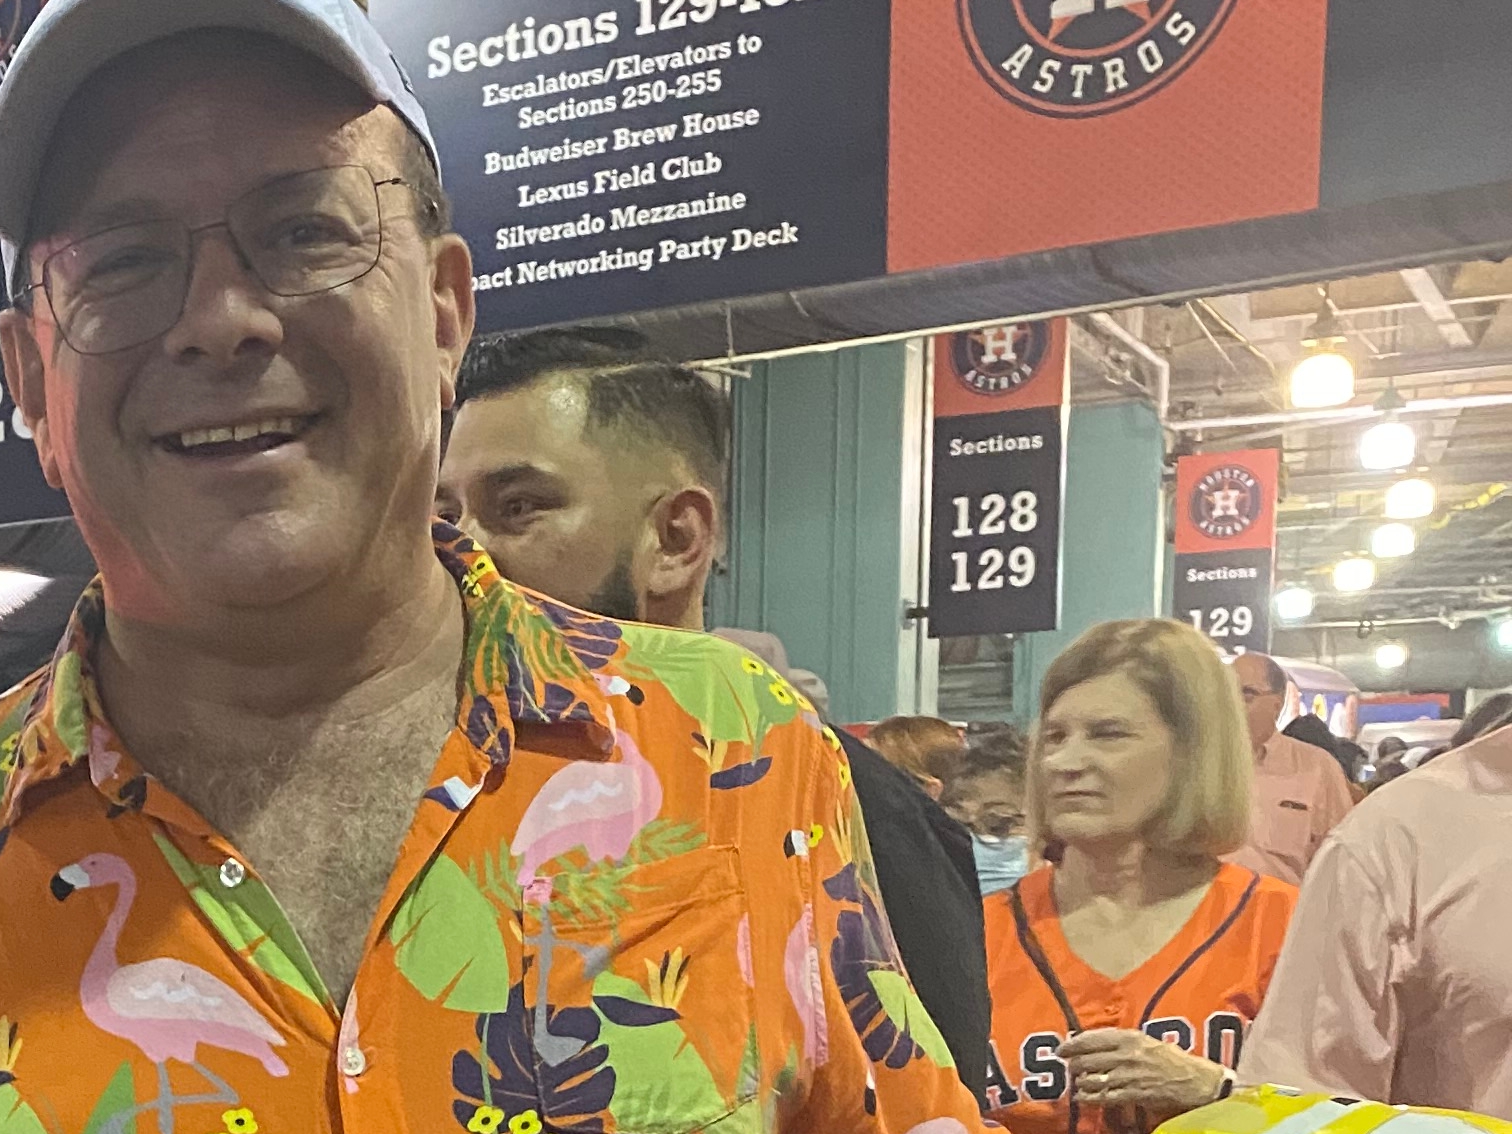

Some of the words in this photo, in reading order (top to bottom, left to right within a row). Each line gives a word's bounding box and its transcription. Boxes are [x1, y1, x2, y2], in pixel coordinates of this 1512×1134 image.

[427, 11, 618, 79] Sections
[482, 41, 732, 107] Escalators/Elevators
[737, 33, 763, 55] to
[1001, 11, 1196, 98] ASTROS
[518, 94, 617, 129] Sections
[622, 69, 722, 110] 250-255
[483, 136, 608, 175] Budweiser
[612, 123, 678, 151] Brew
[683, 107, 760, 138] House
[517, 178, 589, 208] Lexus
[594, 165, 656, 195] Field
[661, 152, 723, 182] Club
[495, 213, 605, 251] Silverado
[609, 192, 747, 231] Mezzanine
[517, 248, 654, 285] Networking
[659, 236, 727, 263] Party
[731, 222, 799, 252] Deck
[949, 434, 1043, 456] Sections
[952, 490, 1038, 537] 128
[951, 545, 1036, 592] 129
[1186, 567, 1258, 582] Sections
[1189, 606, 1253, 637] 129
